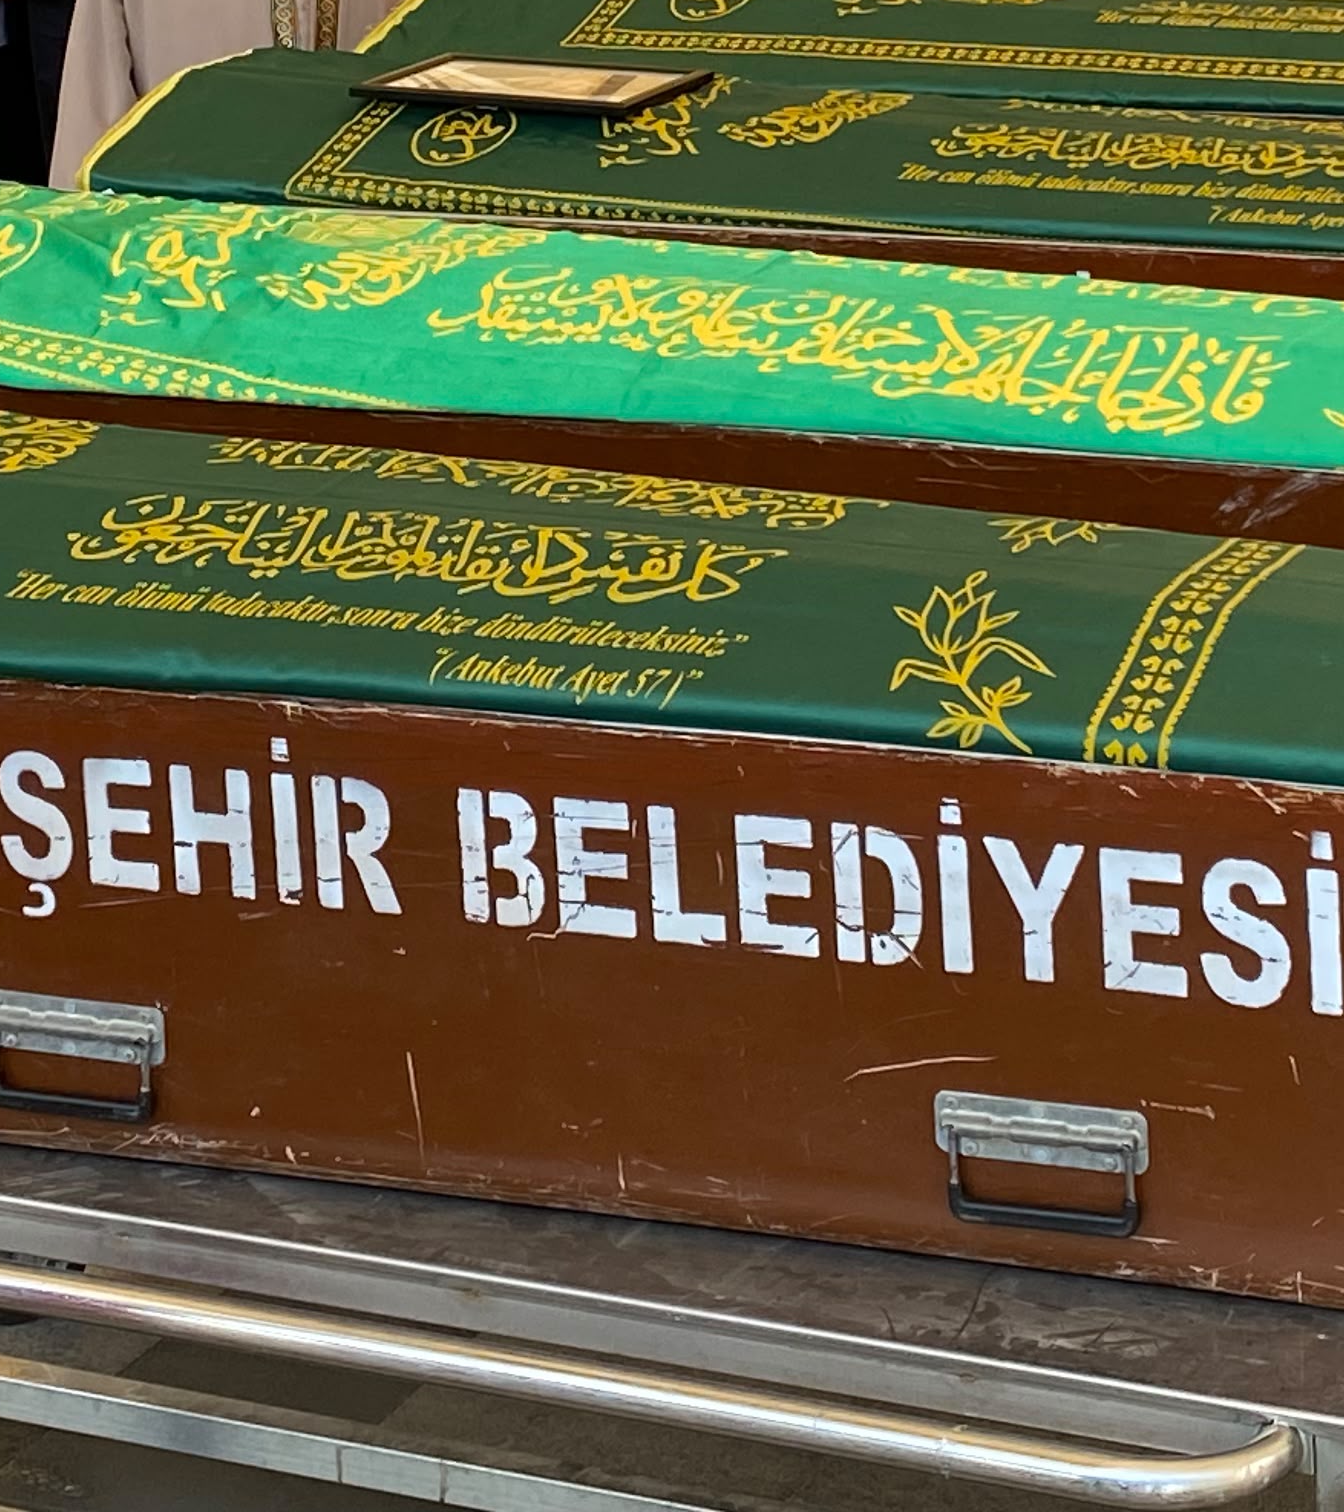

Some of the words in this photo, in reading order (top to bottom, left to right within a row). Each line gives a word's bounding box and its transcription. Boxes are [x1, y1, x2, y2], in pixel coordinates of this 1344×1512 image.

[62, 584, 118, 605] can
[114, 580, 211, 612] ölümü
[416, 605, 479, 637] bize
[558, 661, 631, 706] Ayet
